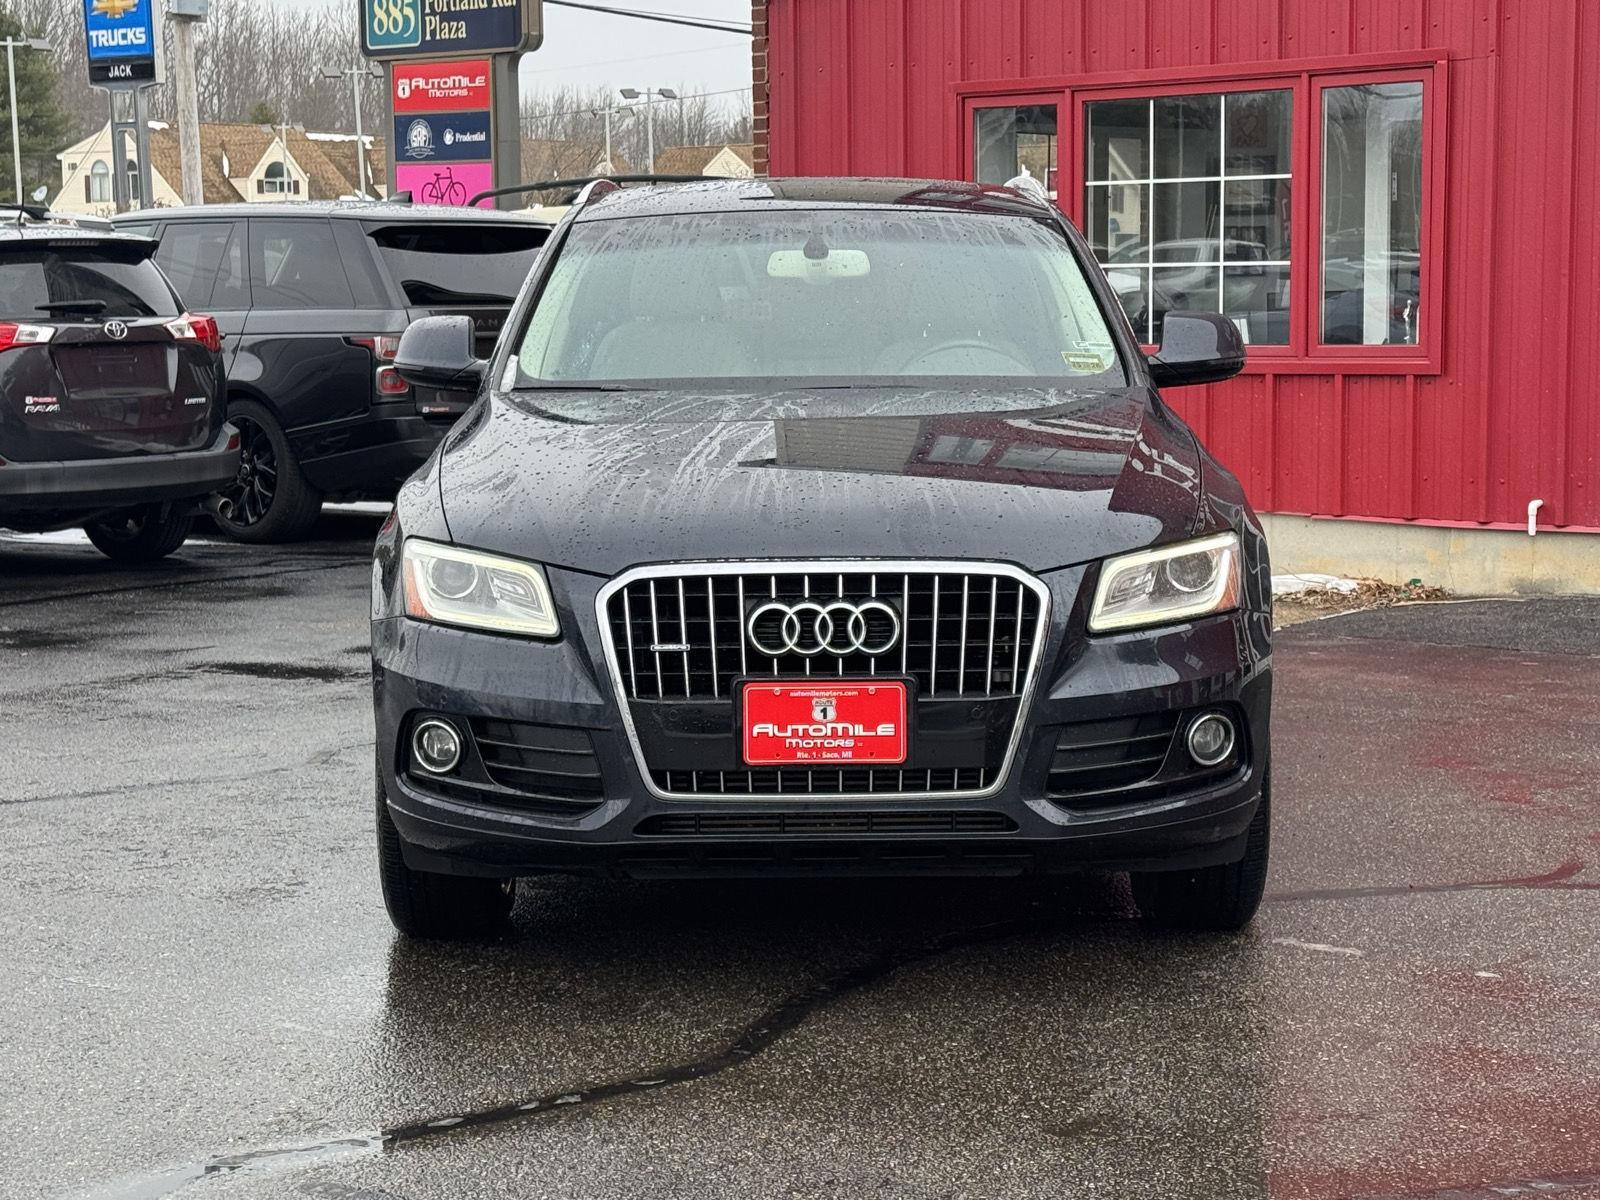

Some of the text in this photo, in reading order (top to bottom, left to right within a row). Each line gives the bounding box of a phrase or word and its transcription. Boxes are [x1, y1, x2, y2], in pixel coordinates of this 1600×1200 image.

[373, 0, 416, 37] 885
[425, 15, 467, 40] Plaza
[89, 27, 146, 48] TRUCKS
[109, 65, 133, 78] JACK
[411, 76, 486, 90] AUTOMILE
[428, 88, 469, 98] MOTORS
[455, 131, 486, 142] Prudential
[820, 707, 828, 720] 1
[752, 722, 896, 737] AUTOMILE
[785, 738, 855, 748] MOTORS
